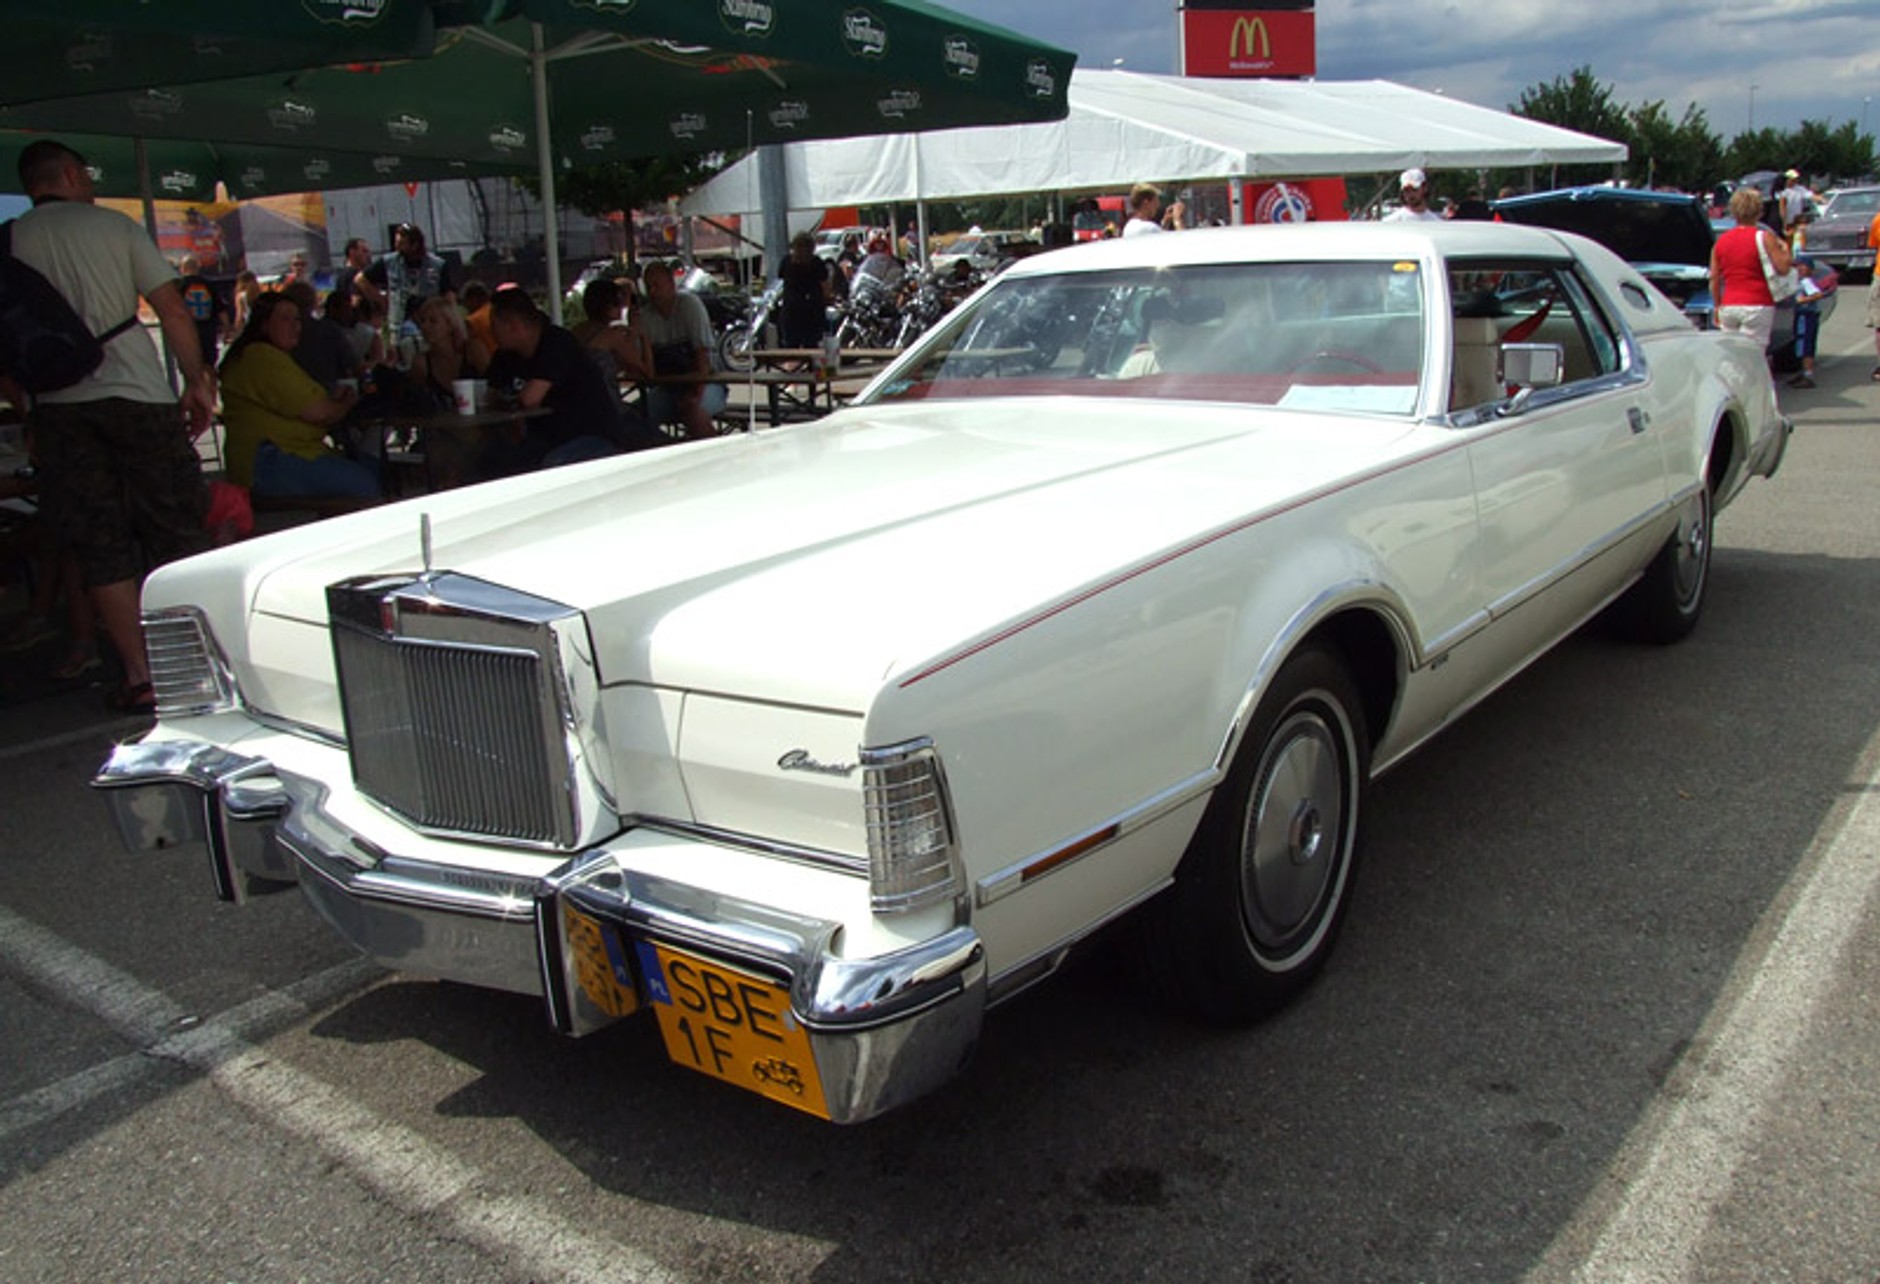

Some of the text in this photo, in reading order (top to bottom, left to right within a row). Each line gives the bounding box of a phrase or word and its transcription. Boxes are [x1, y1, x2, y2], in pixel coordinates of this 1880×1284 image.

[650, 978, 669, 997] PL
[669, 960, 785, 1044] SBE
[677, 1016, 733, 1074] 1F
